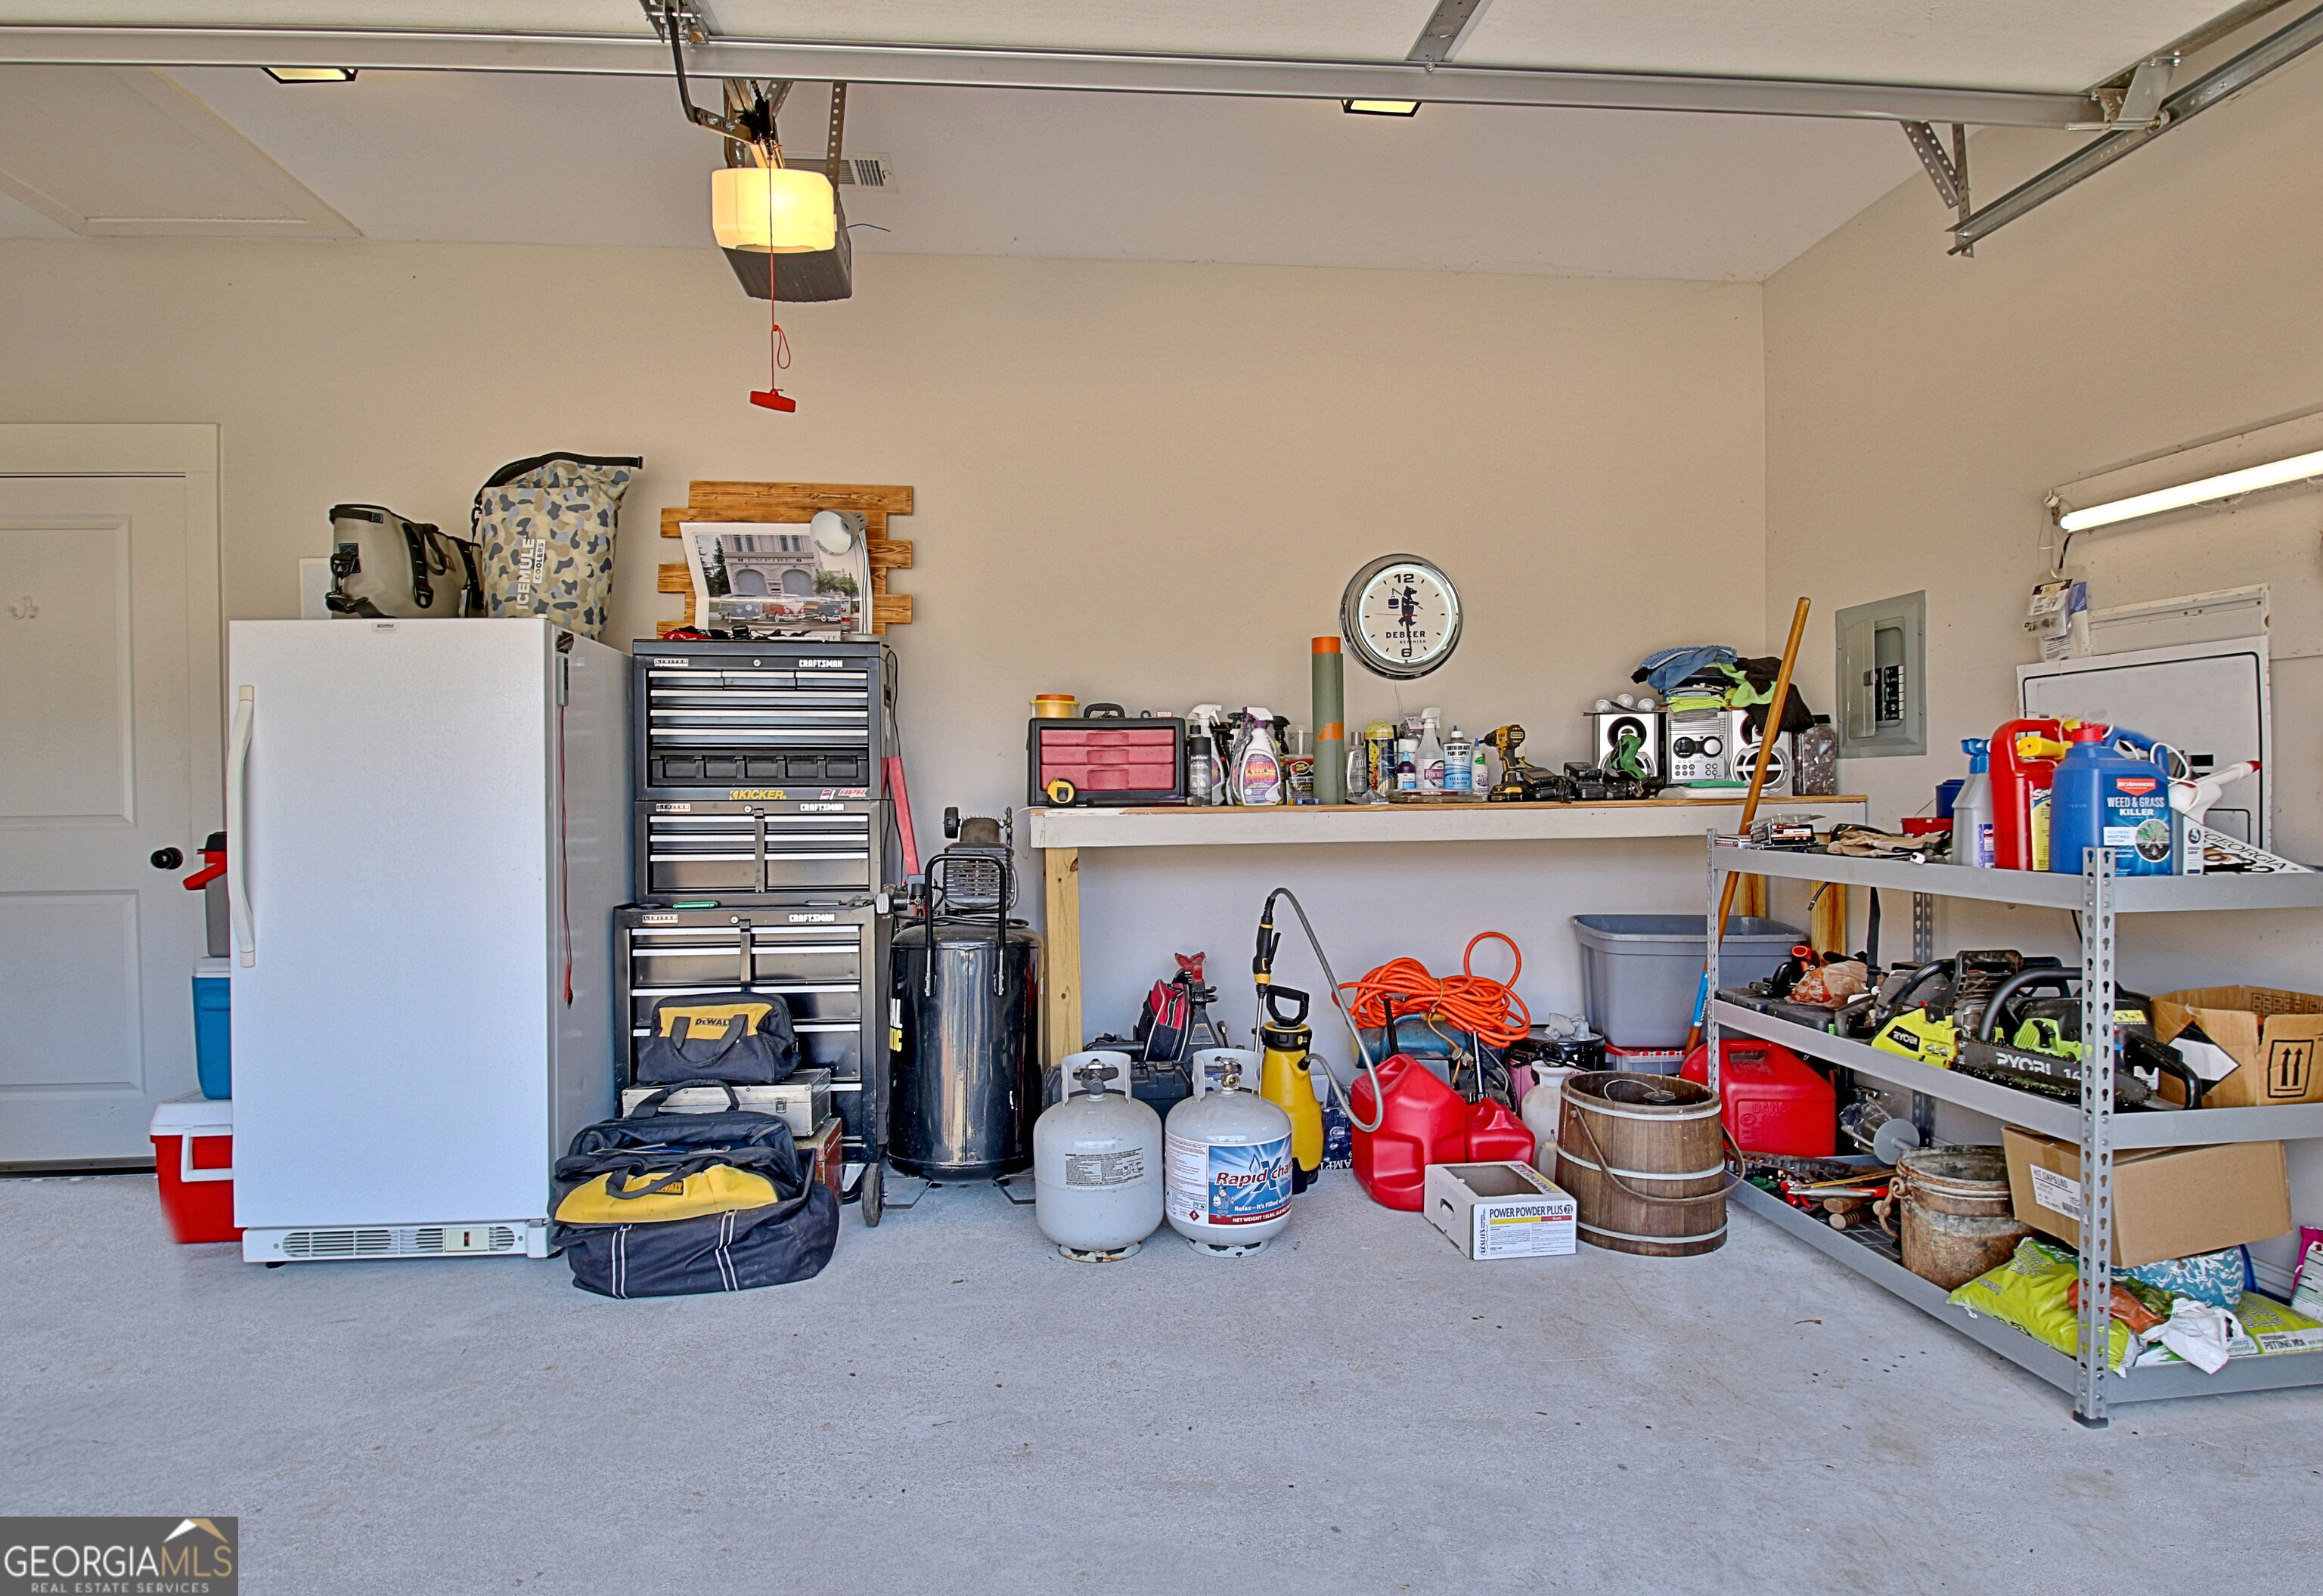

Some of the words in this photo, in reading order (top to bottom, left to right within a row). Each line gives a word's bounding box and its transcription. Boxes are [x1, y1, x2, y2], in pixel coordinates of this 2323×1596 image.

[535, 542, 544, 581] COOLERS
[516, 538, 535, 609] ICEMULE
[1394, 574, 1414, 583] 12
[1401, 648, 1412, 657] 6
[799, 659, 843, 668] CRAFTSMAN
[1245, 763, 1276, 773] PURPLE
[1246, 772, 1276, 783] POWER
[738, 790, 783, 800] KICKER
[800, 803, 845, 811] CRAFTSMAN
[2107, 797, 2130, 807] WEED
[2132, 797, 2138, 807] &
[2139, 797, 2165, 807] GRASS
[2205, 833, 2287, 869] GEORGIA
[789, 913, 836, 922] CRAFTSMAN
[1893, 1030, 1918, 1045] RYOBI
[1996, 1052, 2052, 1075] RYOBI
[1266, 1199, 1278, 1207] Filled
[1490, 1207, 1515, 1218] POWER
[1515, 1206, 1546, 1217] POWDER
[1547, 1205, 1563, 1215] PLUS
[2263, 1339, 2292, 1350] POTTING
